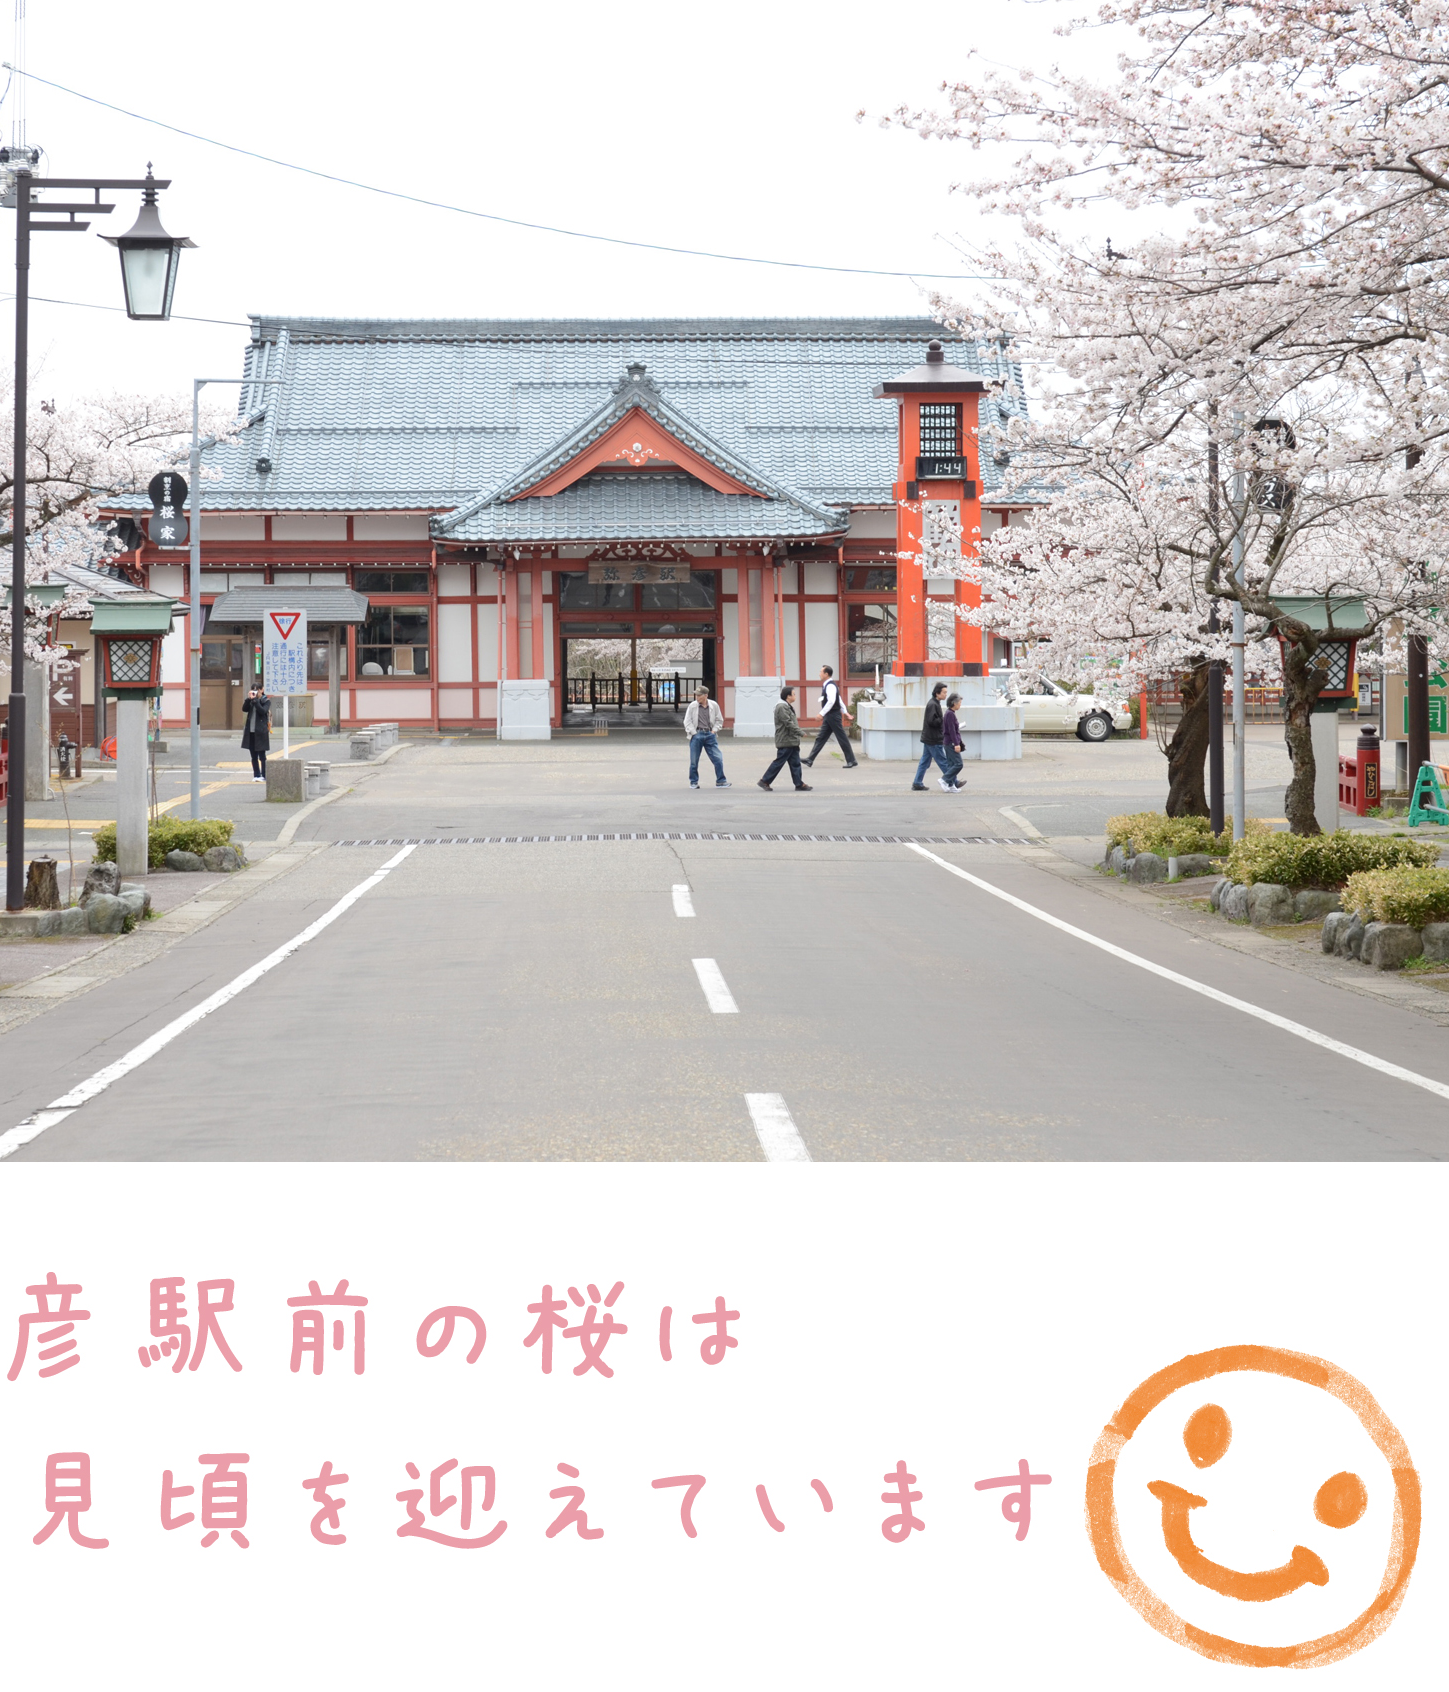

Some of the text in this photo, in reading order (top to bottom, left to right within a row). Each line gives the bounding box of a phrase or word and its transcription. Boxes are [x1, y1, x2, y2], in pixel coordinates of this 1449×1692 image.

[934, 462, 962, 474] 1:44
[159, 505, 176, 540] 桜家
[278, 617, 292, 625] 徐行
[52, 658, 74, 682] P
[271, 642, 279, 693] 注意して下さい
[288, 649, 296, 693] 駅構内につき
[296, 642, 304, 685] これより先は
